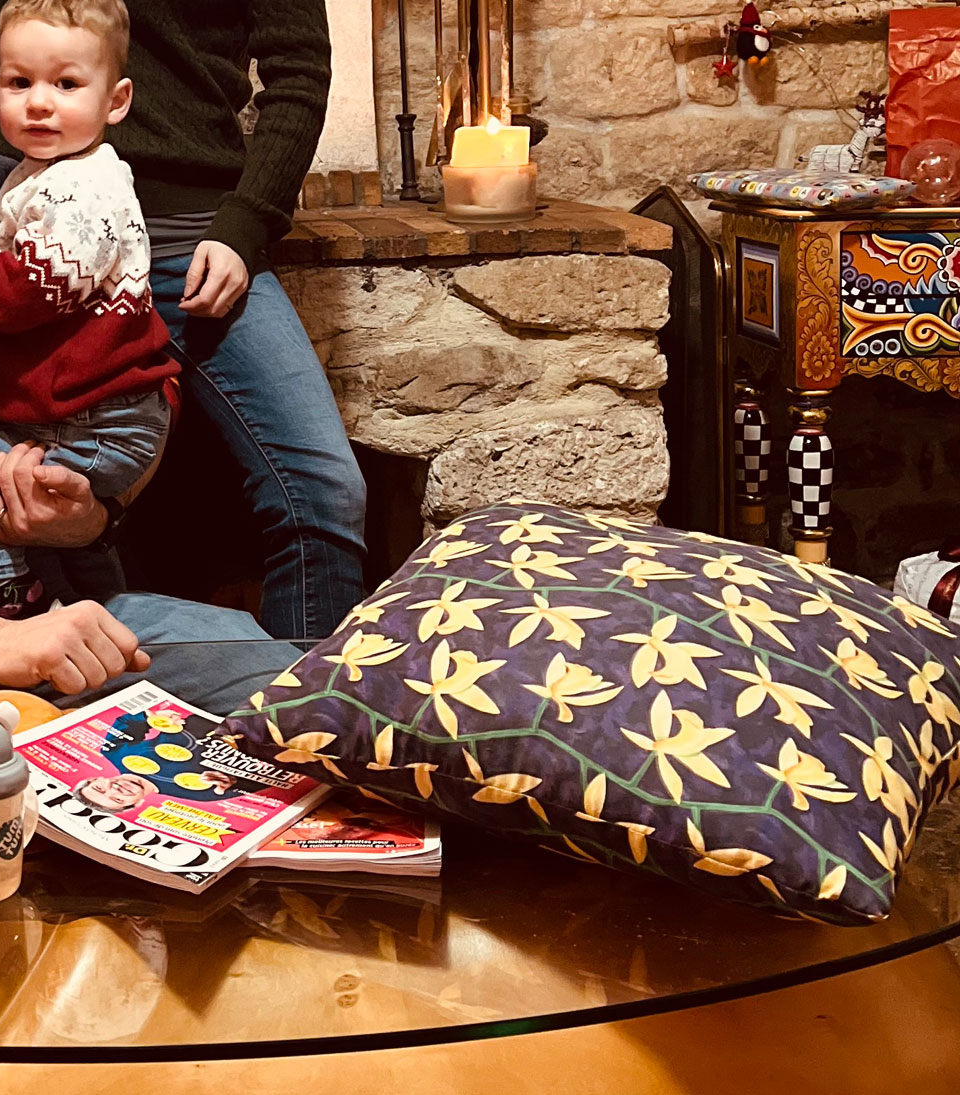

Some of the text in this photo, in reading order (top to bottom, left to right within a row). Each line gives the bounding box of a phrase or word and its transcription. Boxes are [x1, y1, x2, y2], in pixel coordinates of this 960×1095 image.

[200, 748, 306, 784] RETROUVER
[146, 811, 219, 835] CERVEAU
[124, 843, 149, 855] Dr.
